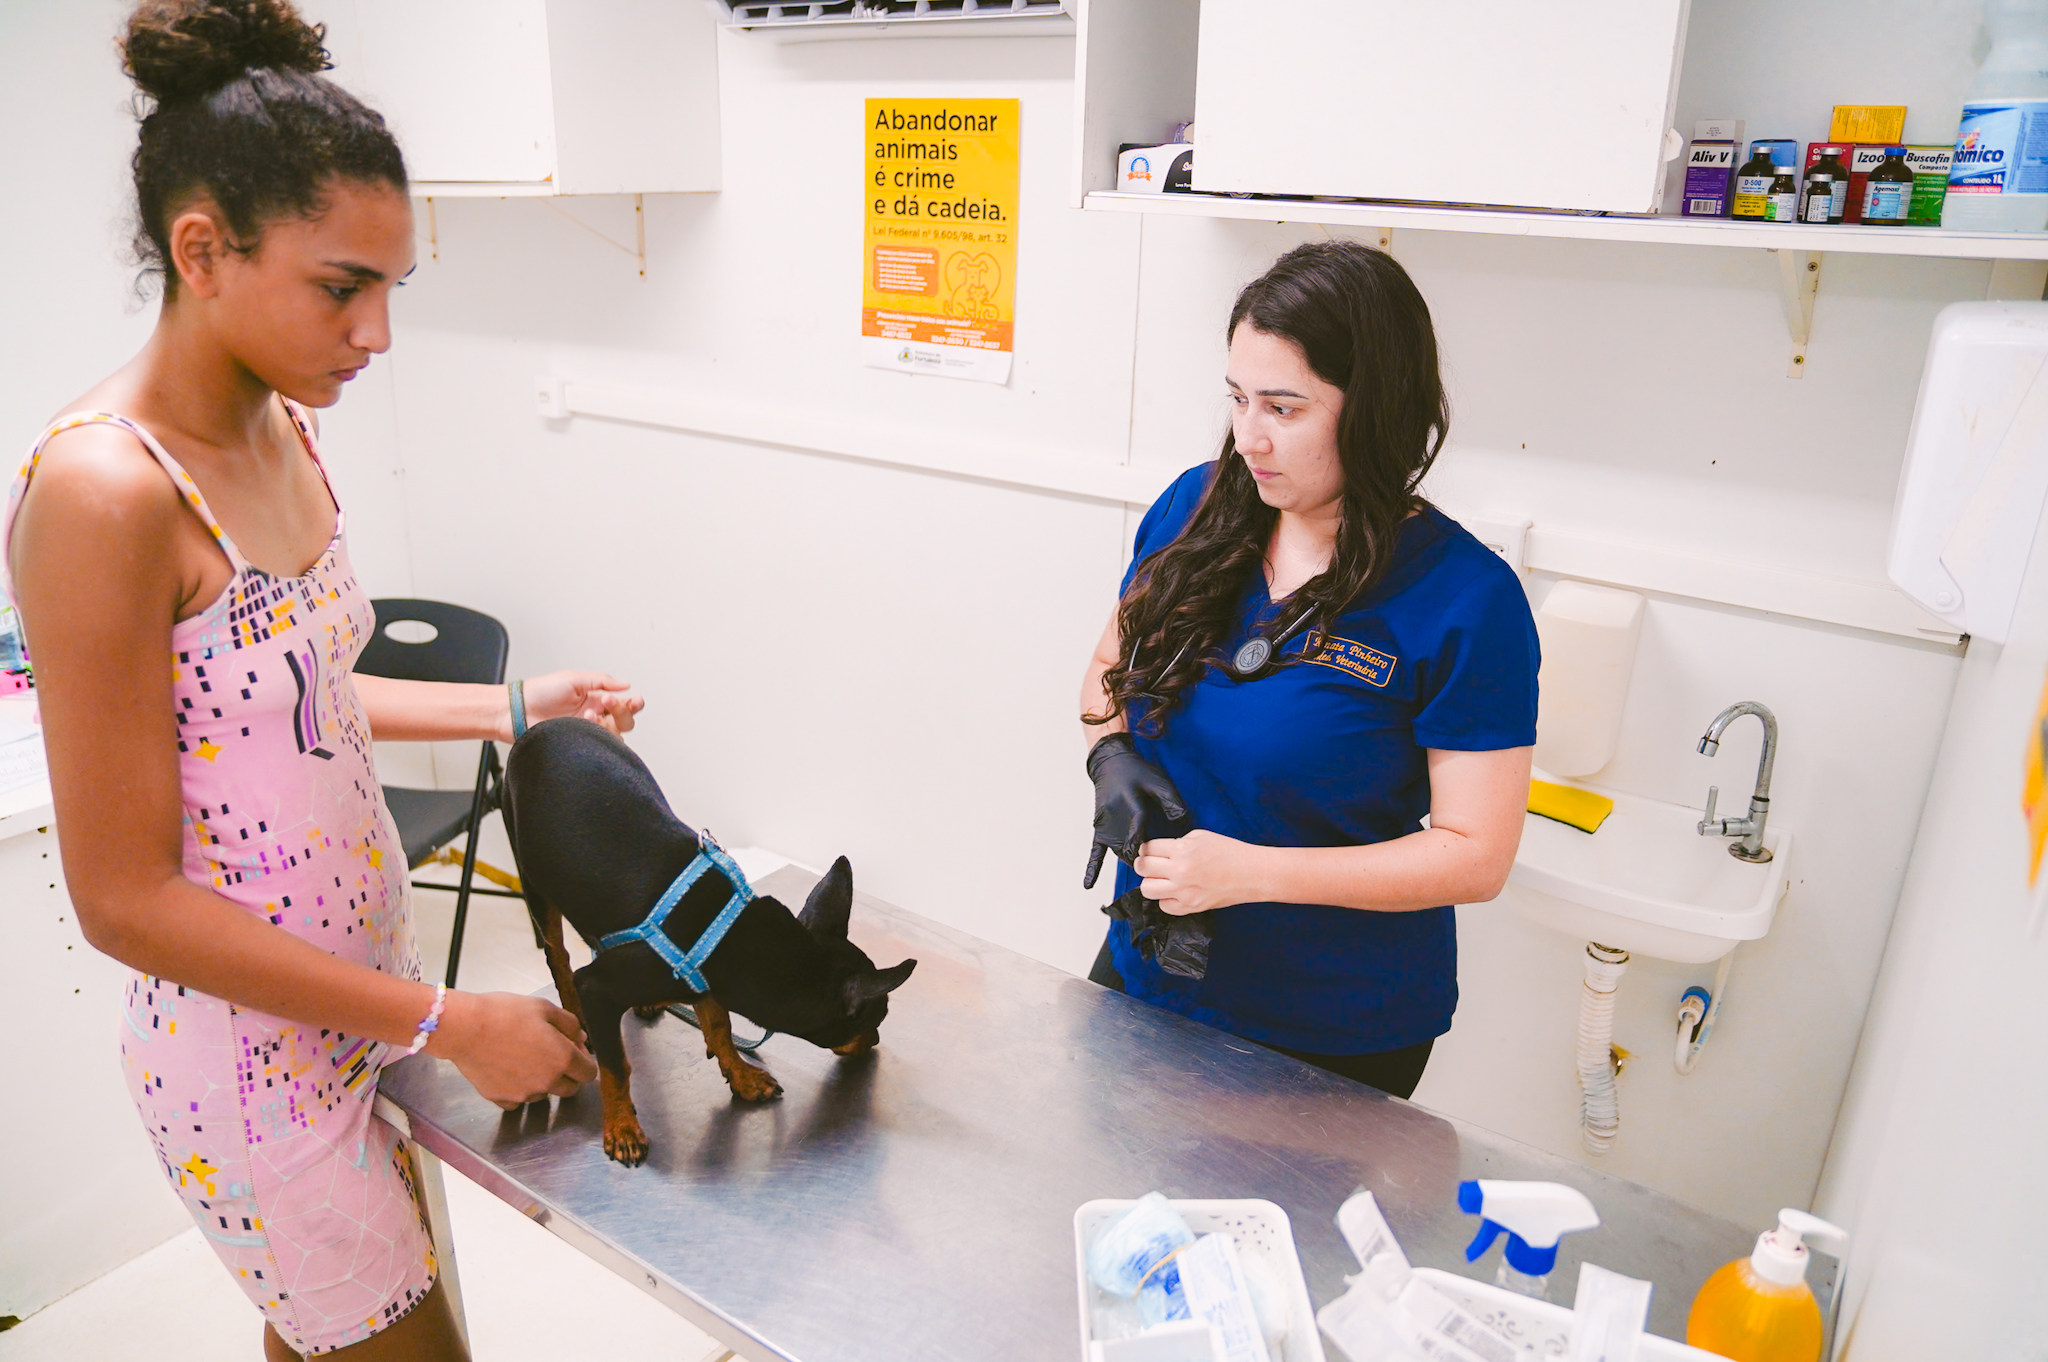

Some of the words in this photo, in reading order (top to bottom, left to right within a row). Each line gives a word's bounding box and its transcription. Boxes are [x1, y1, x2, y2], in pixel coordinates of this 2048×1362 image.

[875, 108, 998, 132] Abandonar
[875, 137, 958, 160] animais
[1691, 150, 1717, 163] Aliv
[1720, 151, 1730, 163] V
[1906, 152, 1950, 165] Buscofin
[875, 165, 886, 187] é
[894, 166, 955, 189] crime
[874, 198, 886, 214] e
[894, 194, 919, 216] dá
[927, 197, 1007, 221] cadeia.
[873, 226, 886, 236] Lei
[888, 227, 920, 238] Federal
[933, 229, 976, 243] 9.605/98,
[978, 233, 994, 243] art.
[996, 234, 1008, 244] 32
[1312, 636, 1346, 652] Rnata
[1348, 645, 1388, 669] Pinheiro
[1335, 654, 1378, 679] Veterinária
